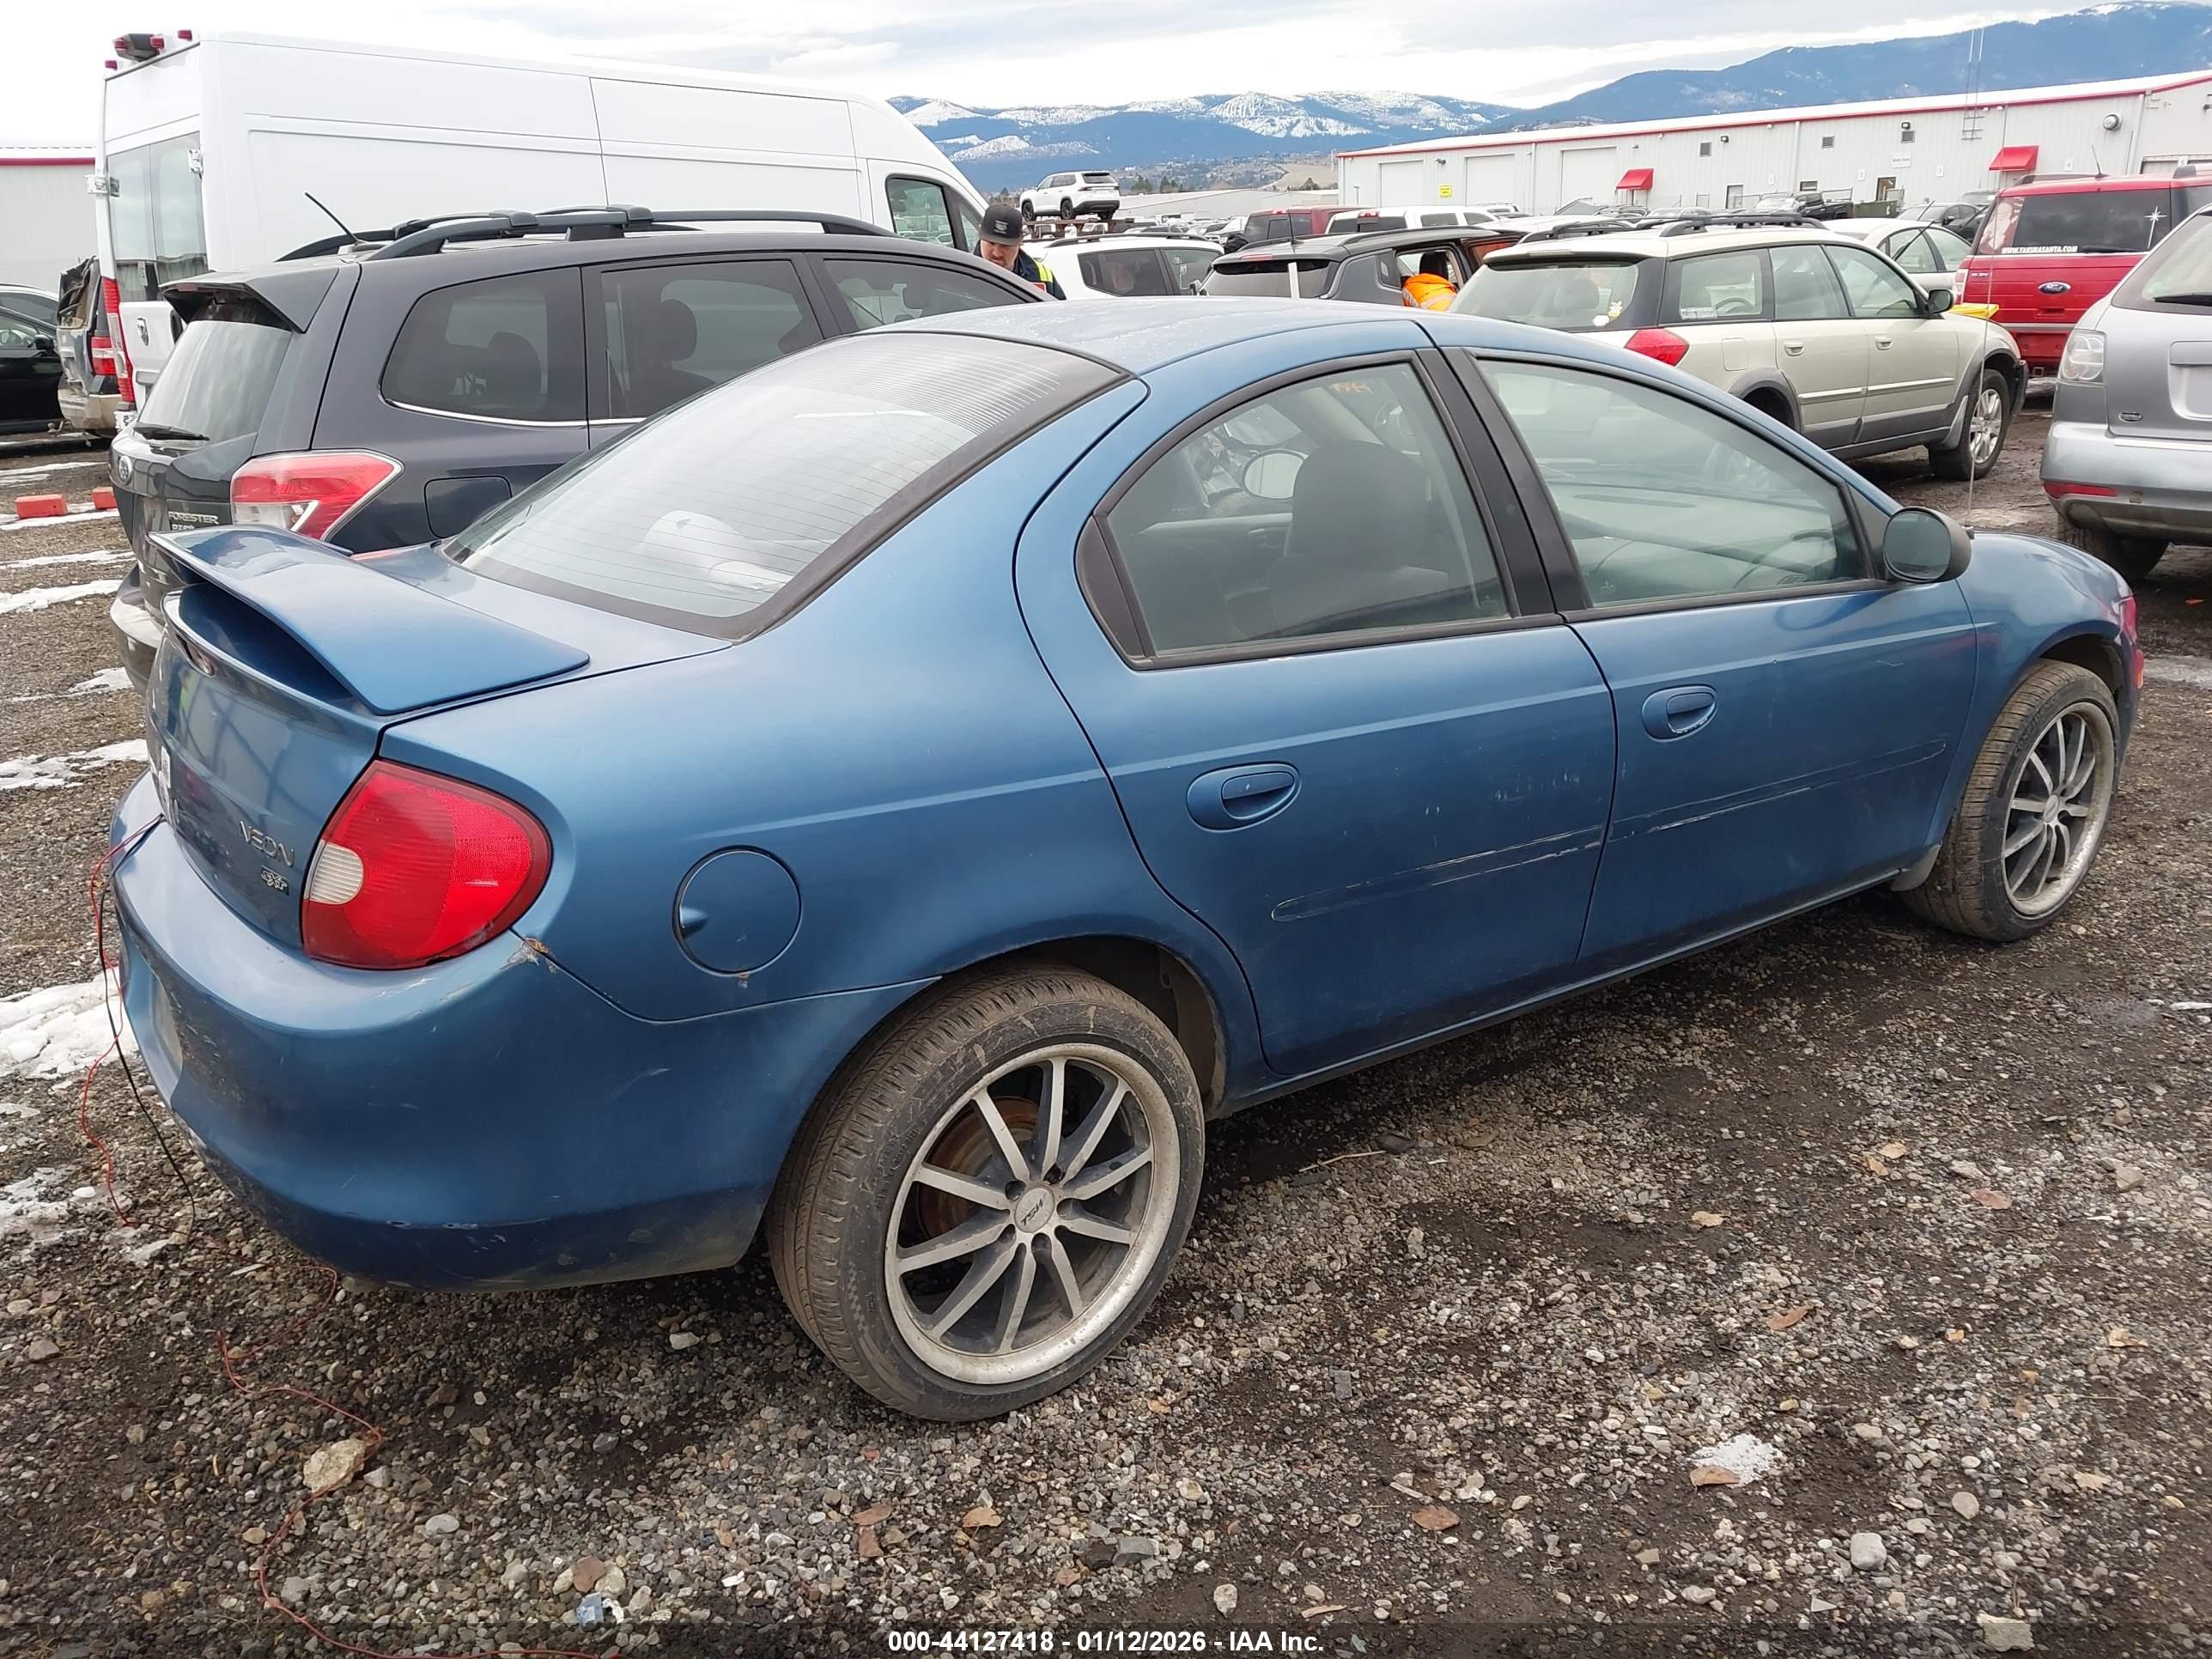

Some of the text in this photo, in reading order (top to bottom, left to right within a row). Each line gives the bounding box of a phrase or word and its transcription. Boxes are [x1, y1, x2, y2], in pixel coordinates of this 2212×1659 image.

[167, 511, 220, 525] FORESTER
[240, 820, 295, 868] NEON
[1020, 1193, 1048, 1226] TSW
